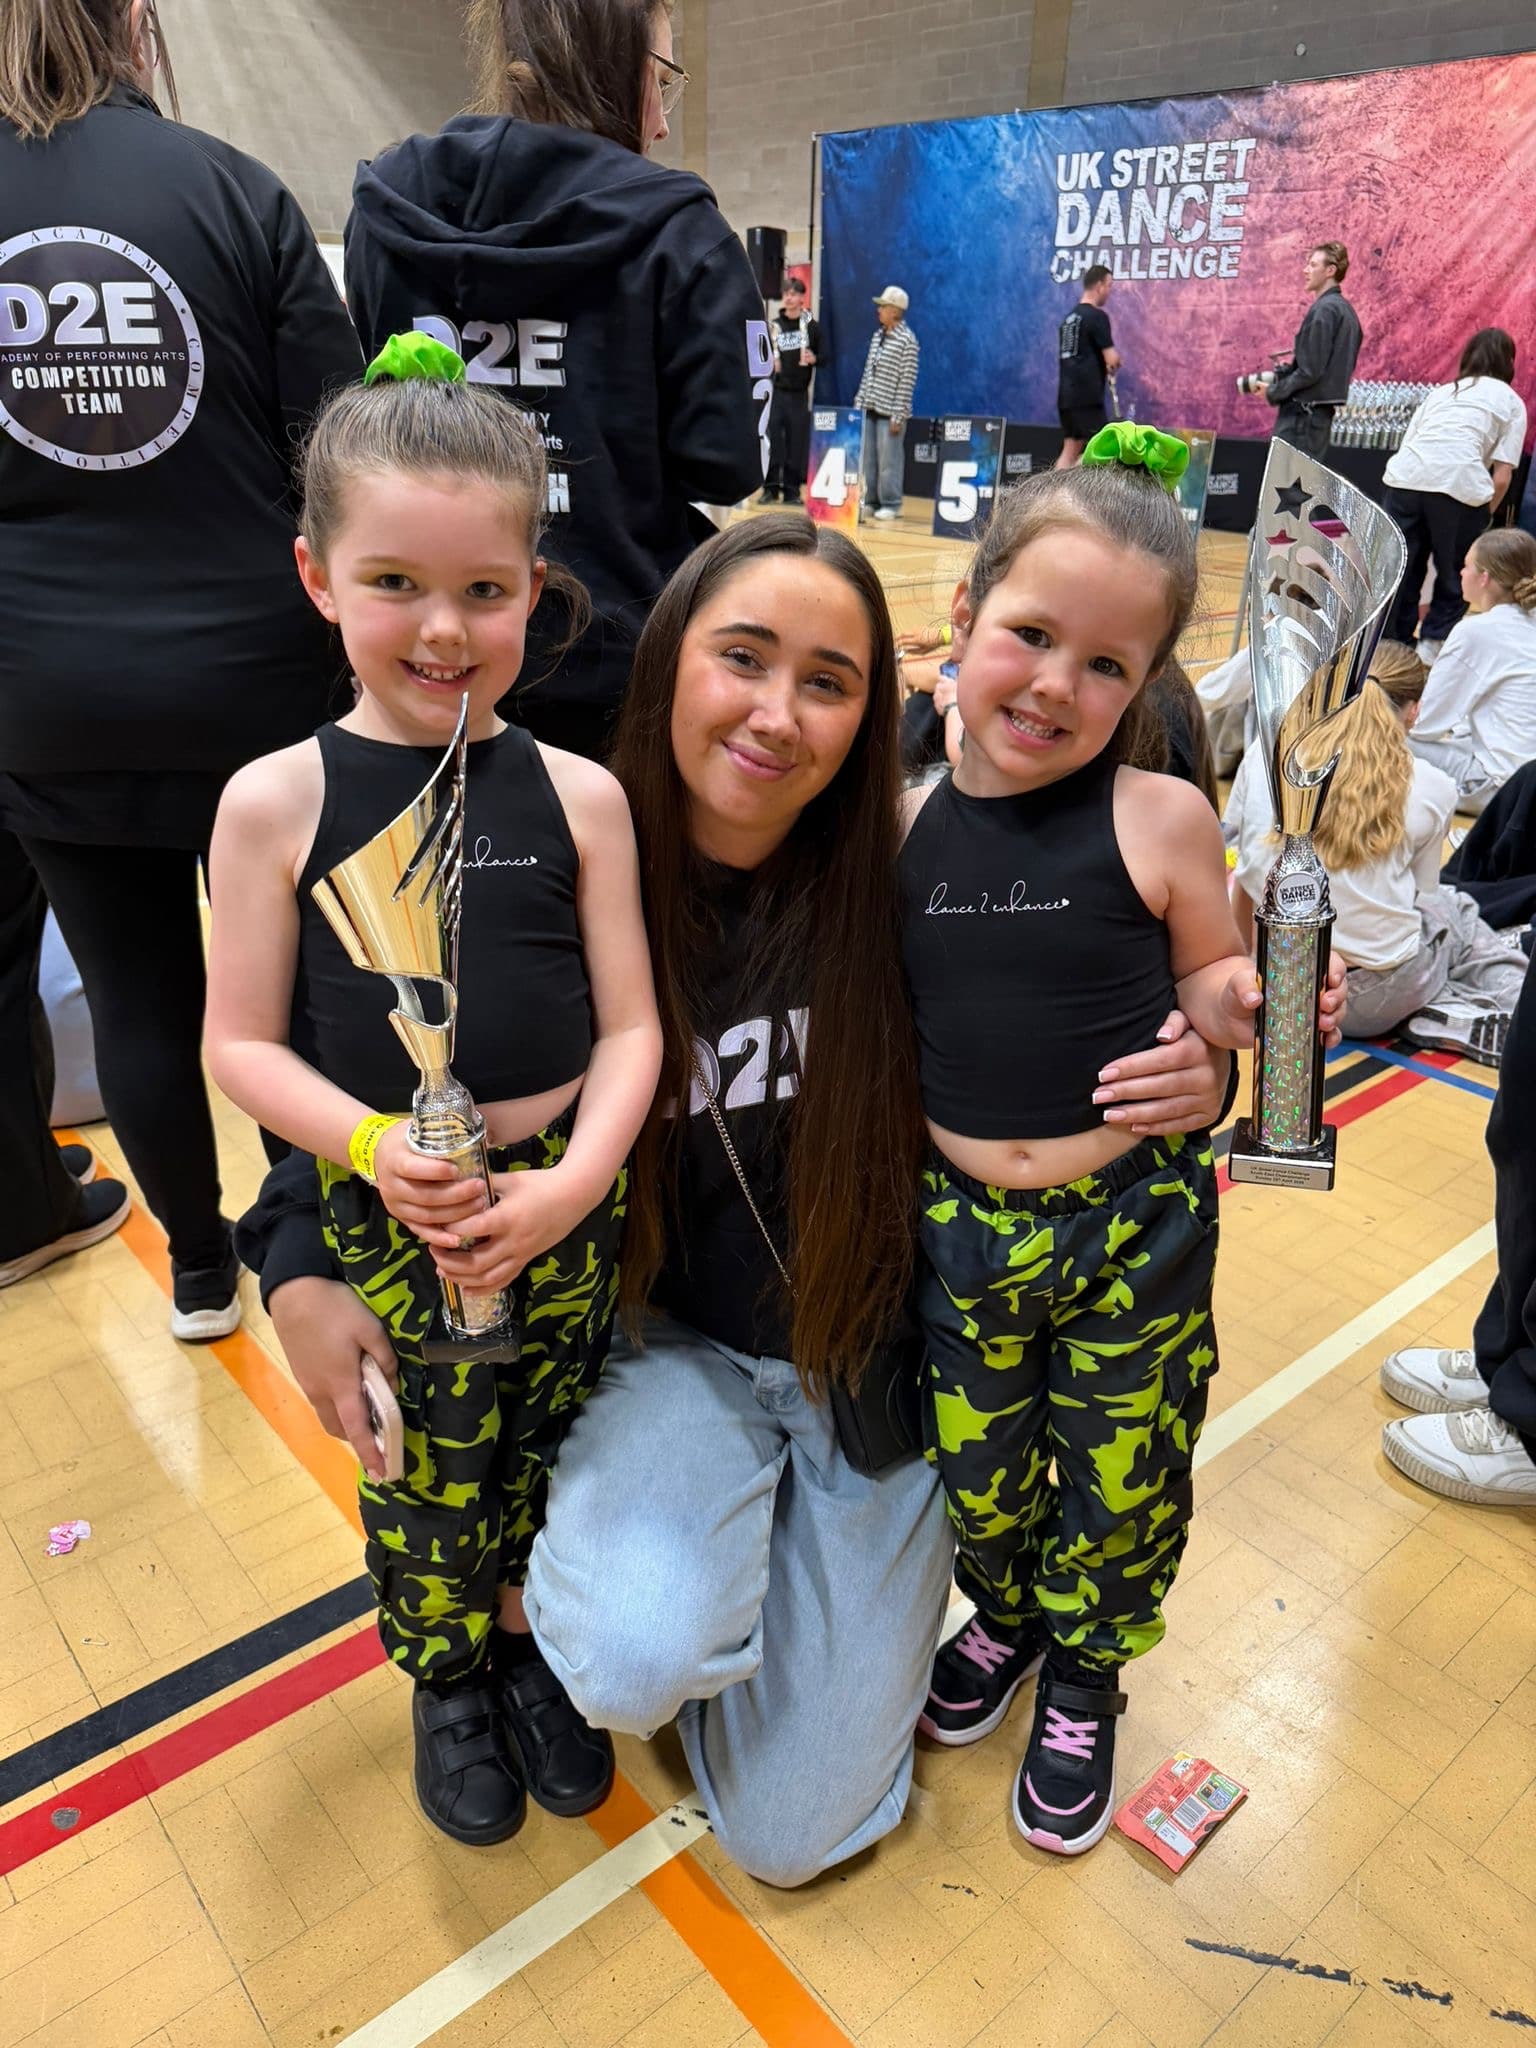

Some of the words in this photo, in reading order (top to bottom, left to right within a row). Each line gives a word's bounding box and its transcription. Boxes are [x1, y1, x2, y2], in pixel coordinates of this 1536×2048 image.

[1056, 151, 1105, 191] UK
[1110, 137, 1257, 188] STREET
[1054, 181, 1250, 247] DANCE
[0, 281, 163, 346] D2E
[45, 352, 61, 361] OF
[67, 351, 149, 361] PERFORMING
[154, 351, 186, 361] ARTS
[11, 366, 167, 390] COMPETITION
[61, 393, 123, 414] TEAM
[462, 836, 533, 869] nhance
[925, 882, 976, 915] dance
[993, 880, 1064, 914] enhance
[1282, 889, 1316, 900] DANCE
